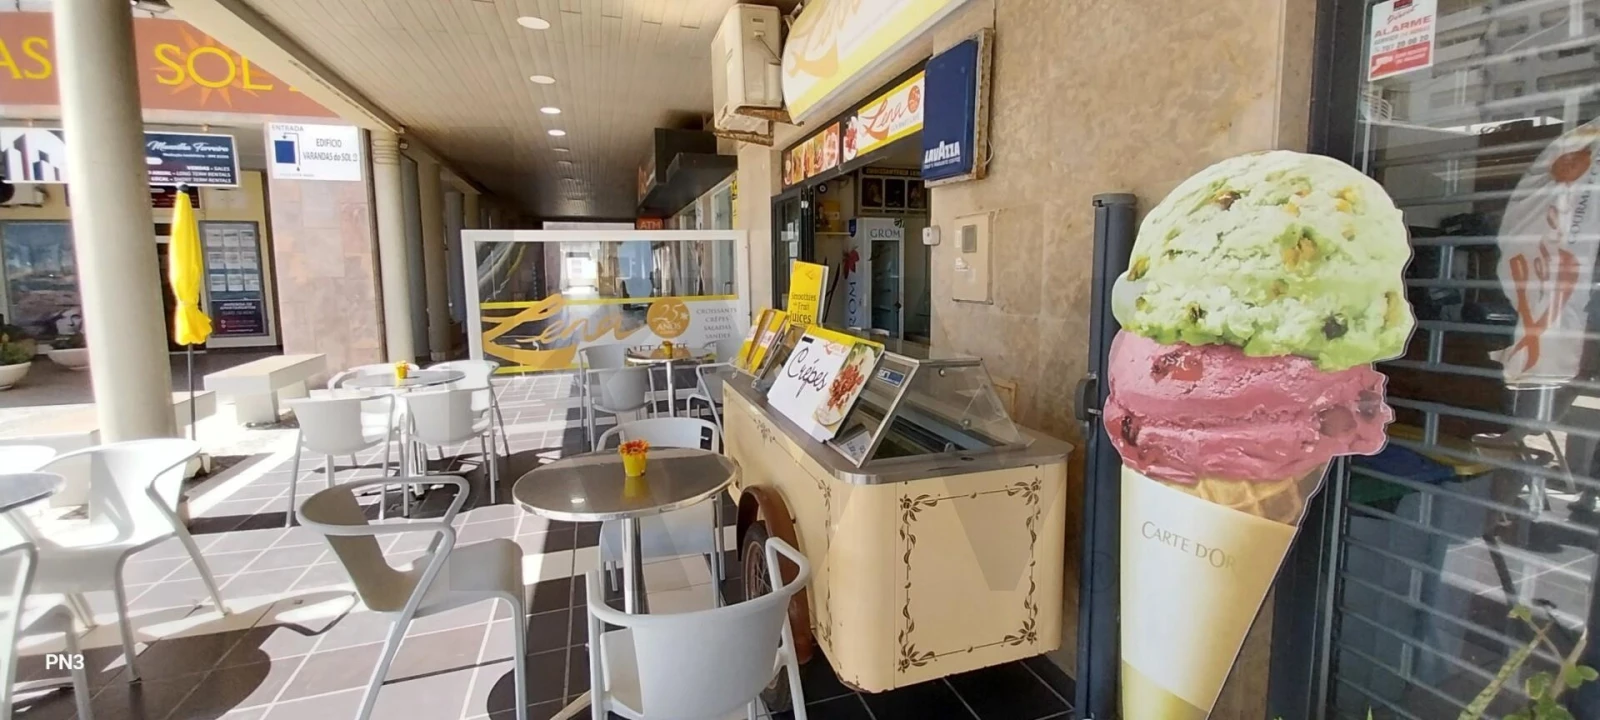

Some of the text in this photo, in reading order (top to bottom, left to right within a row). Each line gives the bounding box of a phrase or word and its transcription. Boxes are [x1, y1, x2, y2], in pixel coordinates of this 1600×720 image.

[1374, 14, 1432, 38] ALARME
[154, 43, 273, 91] SOL
[271, 124, 304, 132] ENTRADA
[302, 151, 333, 161] VARANDAS
[341, 152, 352, 162] SOL
[924, 140, 960, 165] LAVAZZA
[640, 219, 661, 230] ATM
[870, 229, 901, 238] GROM
[790, 292, 817, 301] Smoothies
[652, 303, 684, 325] 25
[695, 307, 738, 315] CROISSANTS
[481, 293, 648, 369] Lena
[1141, 520, 1237, 571] CARTE D'OR
